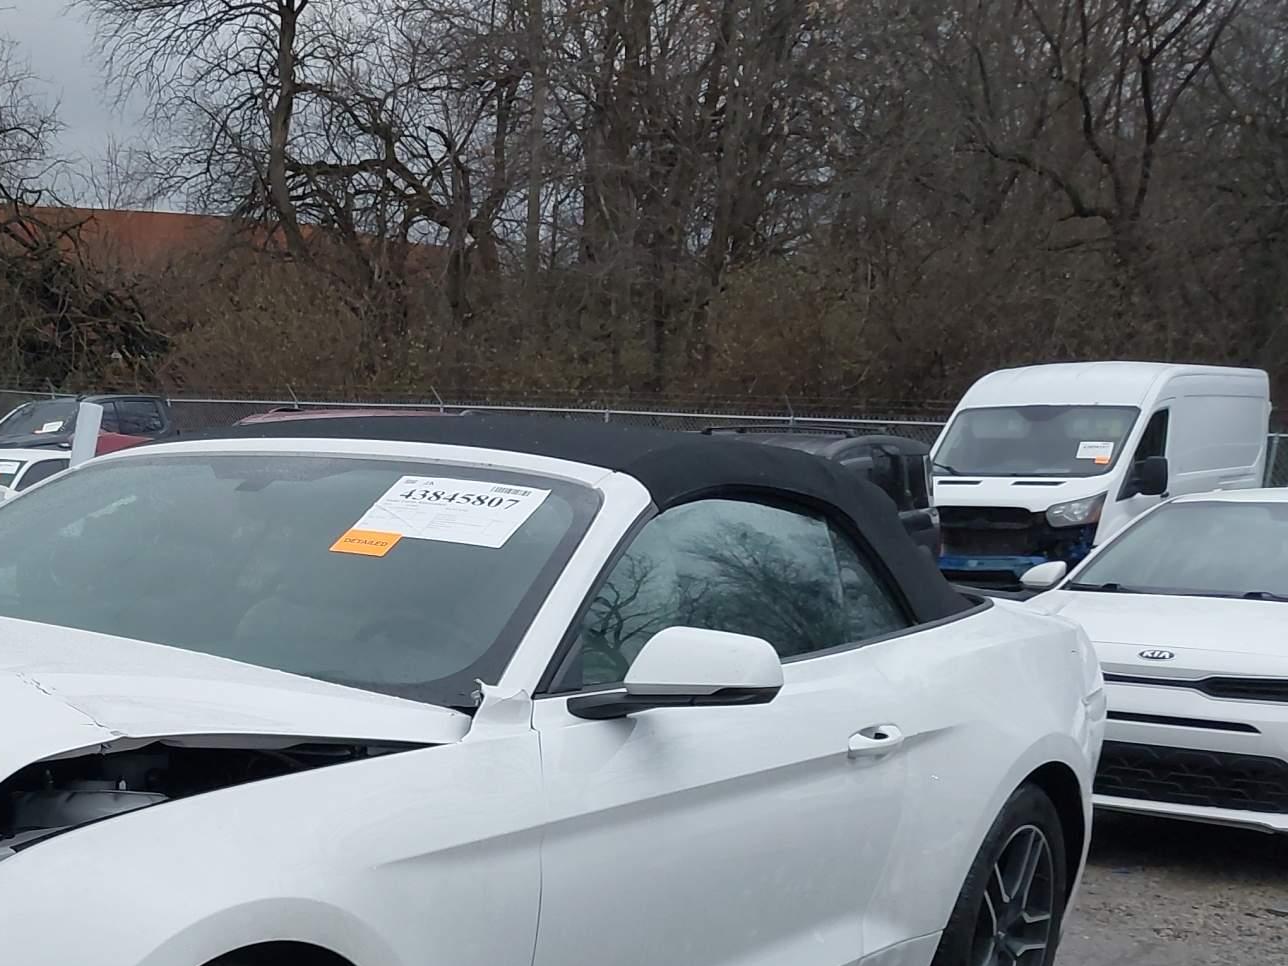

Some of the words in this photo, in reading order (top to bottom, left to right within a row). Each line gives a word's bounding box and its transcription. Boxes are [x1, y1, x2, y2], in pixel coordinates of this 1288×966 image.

[399, 488, 520, 510] 43845807
[343, 537, 389, 547] DETAILED
[1142, 650, 1170, 659] KIA
